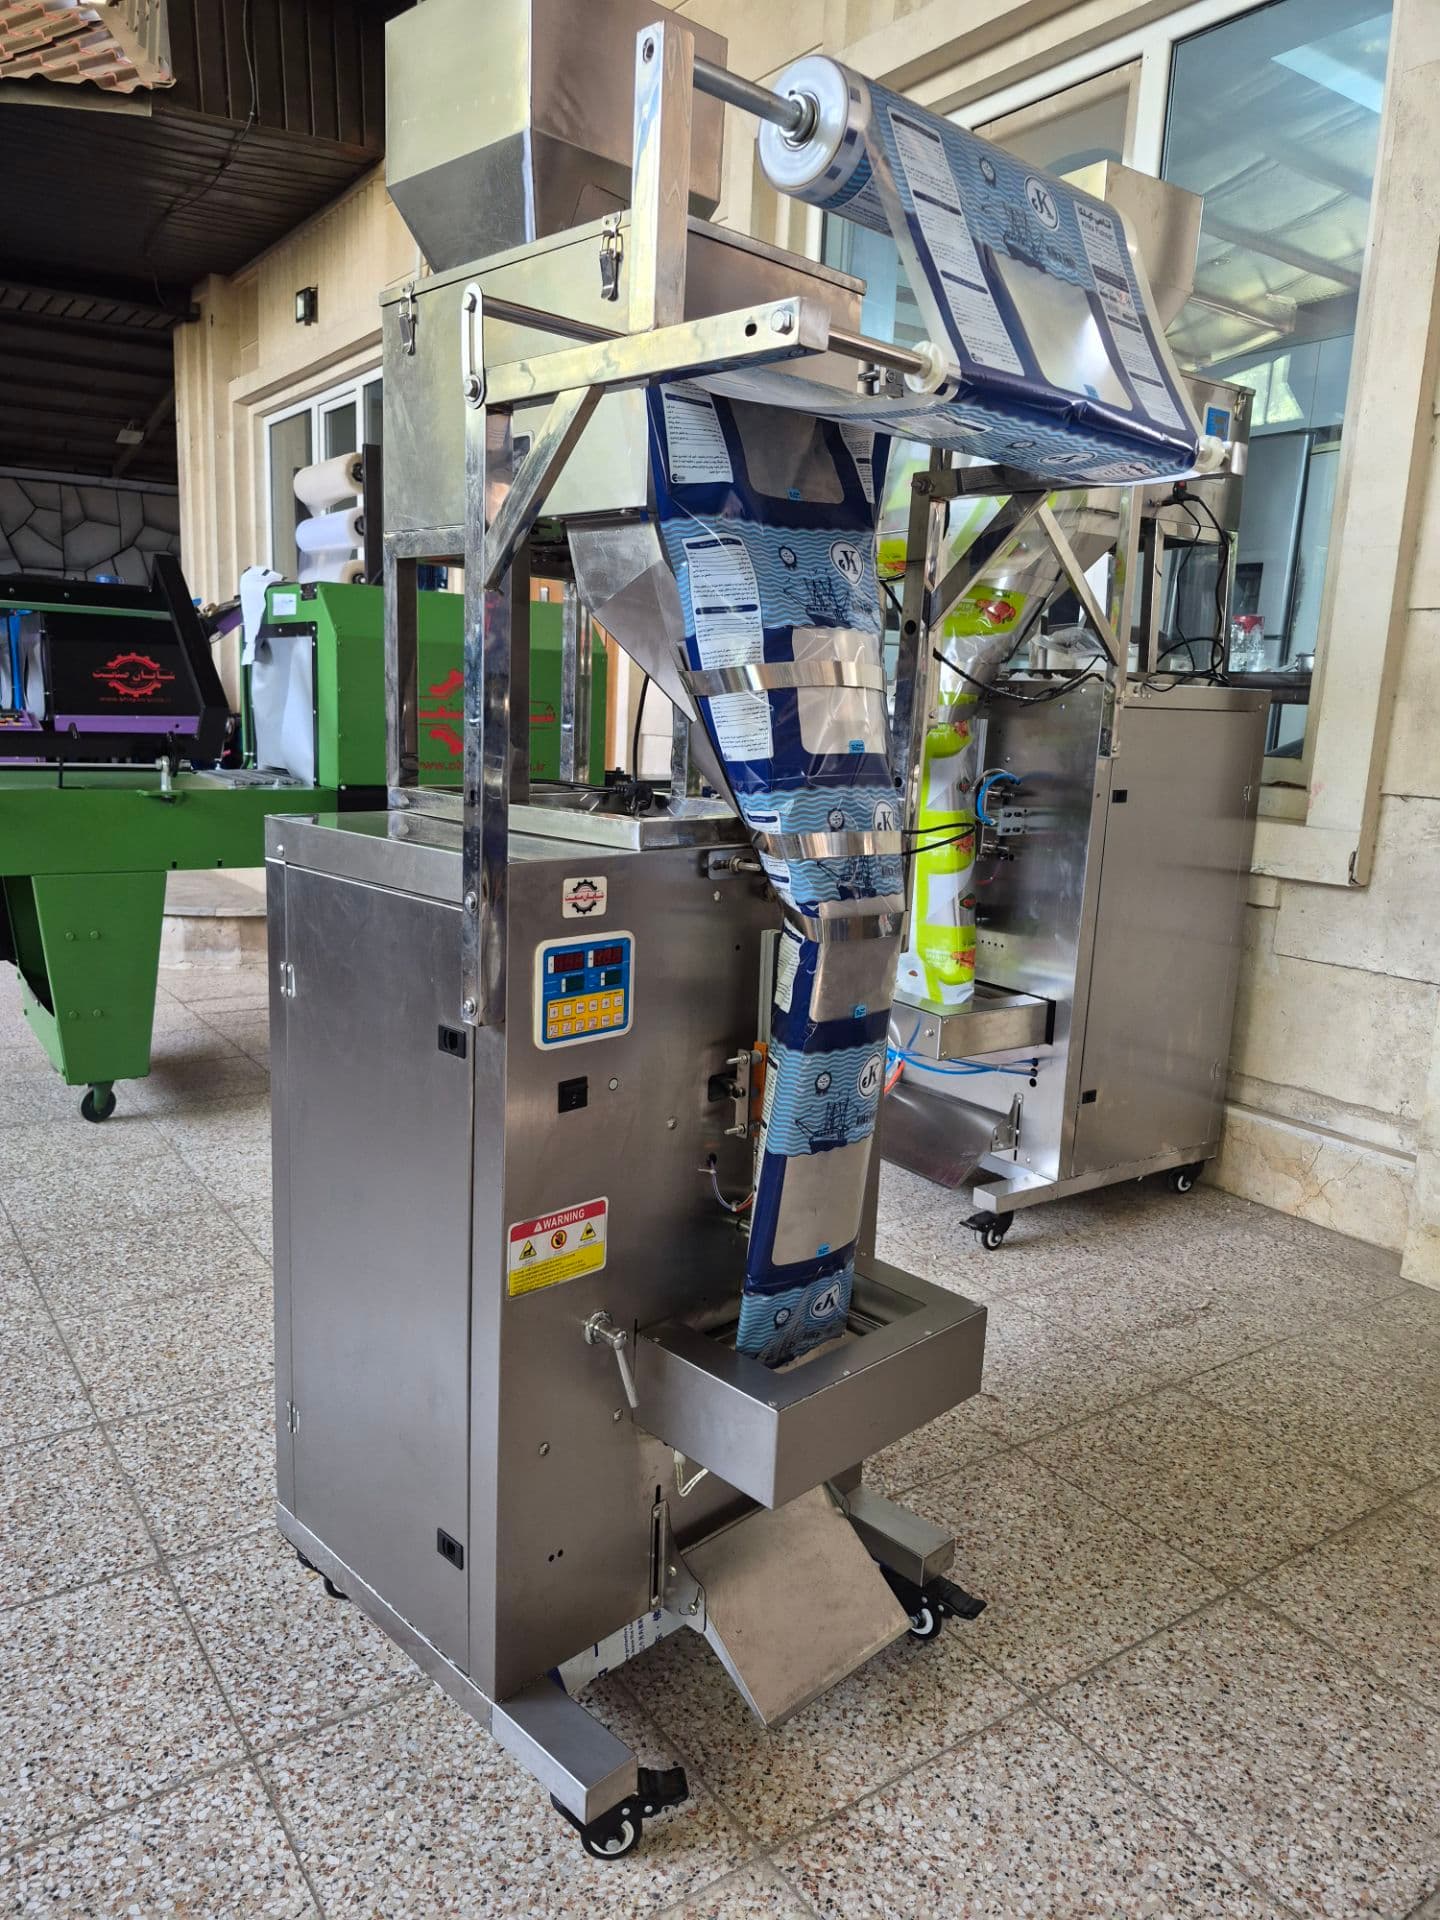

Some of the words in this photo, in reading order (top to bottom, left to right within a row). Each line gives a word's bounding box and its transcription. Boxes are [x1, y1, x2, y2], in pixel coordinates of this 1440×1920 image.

[92, 669, 130, 679] صنعت
[132, 669, 176, 682] شایان
[543, 1208, 585, 1230] WARNING
